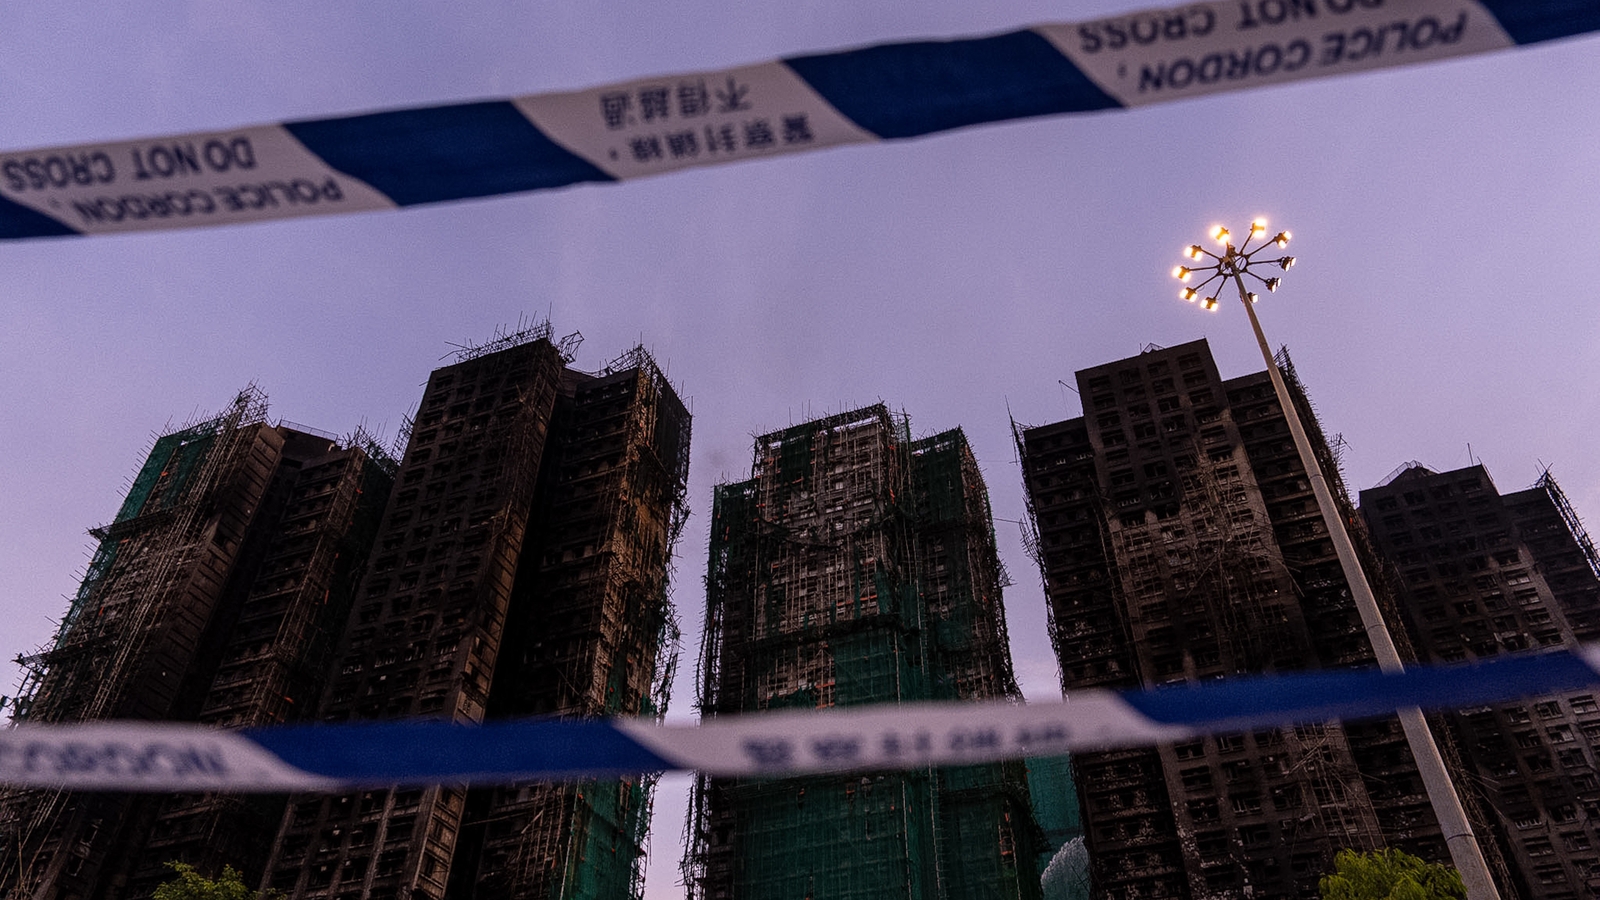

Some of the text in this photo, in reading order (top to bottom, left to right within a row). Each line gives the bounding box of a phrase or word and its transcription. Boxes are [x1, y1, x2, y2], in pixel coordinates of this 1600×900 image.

[1077, 8, 1216, 54] CROSS
[1237, 0, 1317, 31] NOT
[1321, 10, 1467, 66] POLICE
[600, 73, 752, 131] 不得越過
[2, 137, 256, 192] DO NOT CROSS
[213, 177, 344, 212] POLICE
